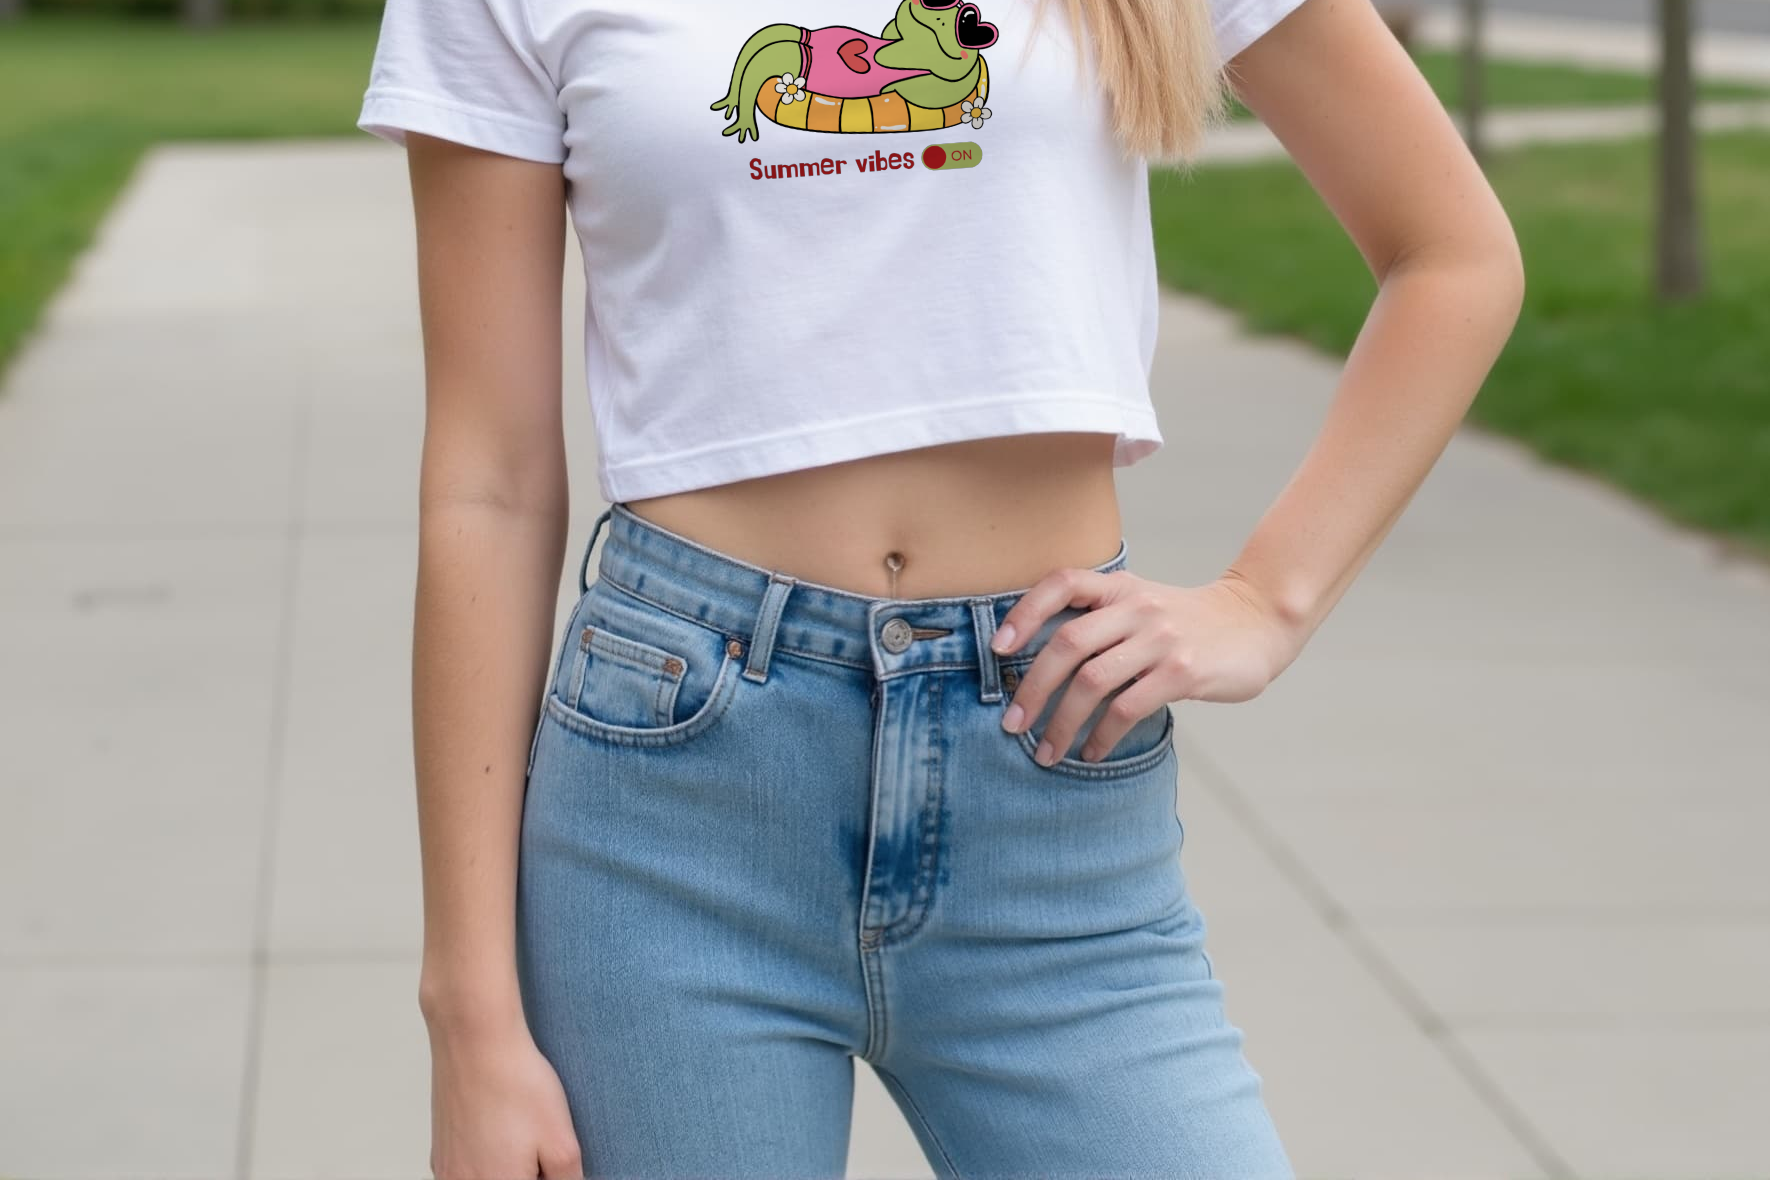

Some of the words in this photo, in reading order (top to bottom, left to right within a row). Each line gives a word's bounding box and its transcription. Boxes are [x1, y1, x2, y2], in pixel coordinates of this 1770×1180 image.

[749, 158, 847, 180] Summer
[855, 150, 915, 173] vibes
[951, 150, 972, 161] ON
